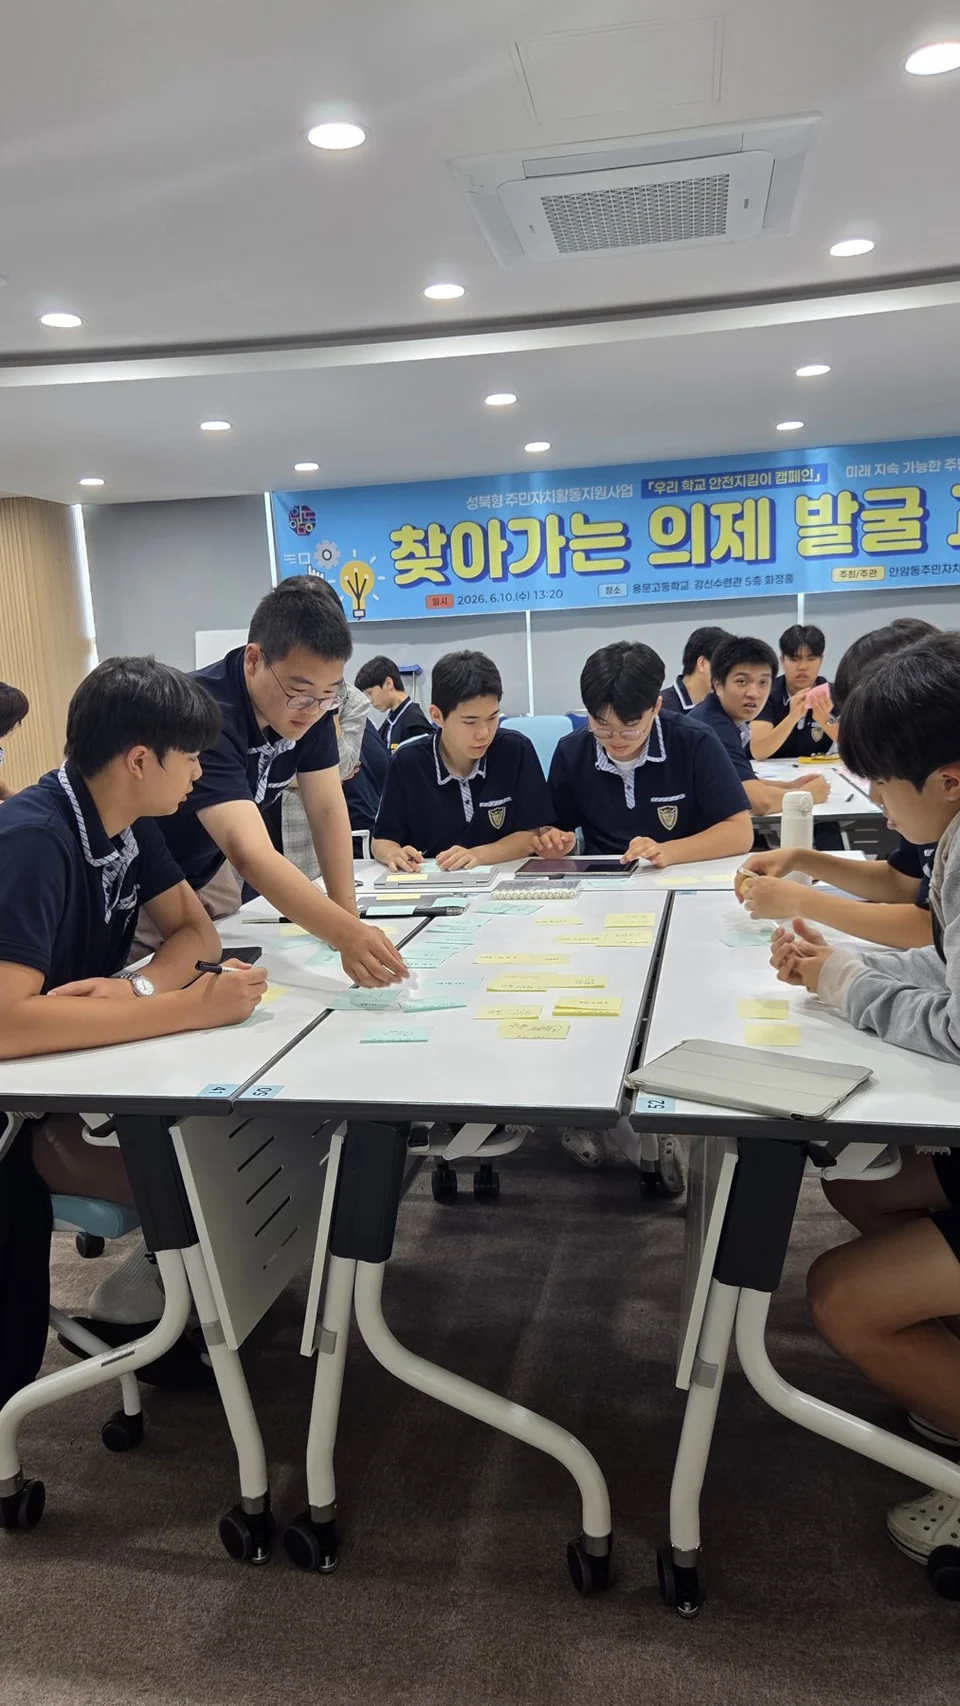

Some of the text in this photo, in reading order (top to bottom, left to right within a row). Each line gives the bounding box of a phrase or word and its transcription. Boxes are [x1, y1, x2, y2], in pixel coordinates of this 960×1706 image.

[466, 493, 503, 510] 성북형
[505, 484, 633, 507] 주민자치활동지원사업
[681, 478, 706, 492] 학교
[709, 471, 772, 490] 안전지킴이
[846, 464, 871, 478] 미래
[874, 462, 900, 476] 지속
[903, 459, 941, 474] 가능한
[389, 511, 629, 586] 찾아가는
[648, 496, 774, 566] 의제
[795, 485, 927, 558] 발굴
[431, 597, 449, 607] 일시
[457, 594, 487, 606] 2026.
[534, 589, 564, 600] 13:20
[604, 585, 621, 596] 장소
[632, 580, 689, 594] 용문고등학교
[745, 575, 762, 587] 5층
[764, 573, 794, 586] 화정홀
[839, 568, 878, 579] 주최/주관
[647, 1099, 665, 1109] 52
